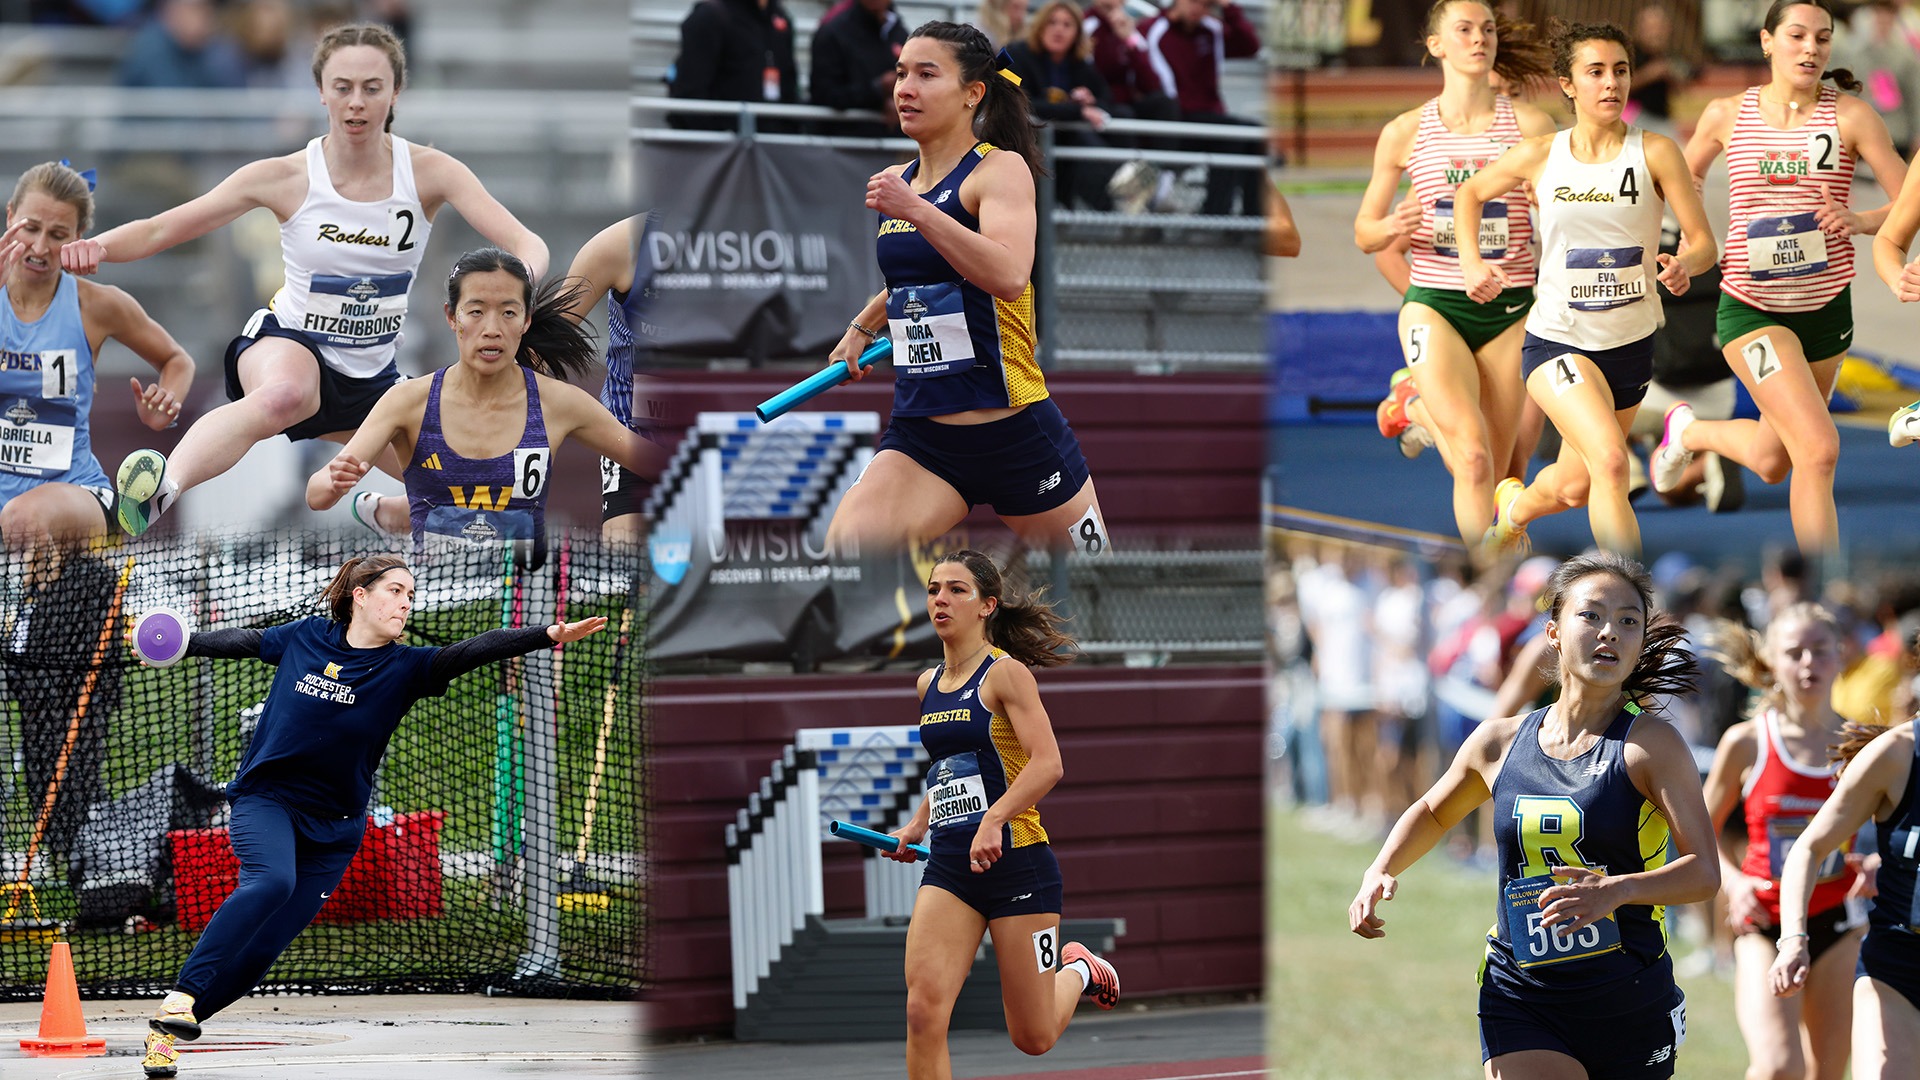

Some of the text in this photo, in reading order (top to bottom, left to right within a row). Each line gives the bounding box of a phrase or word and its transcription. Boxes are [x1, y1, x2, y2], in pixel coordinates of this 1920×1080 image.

[1815, 133, 1834, 170] 2
[1445, 169, 1480, 184] WA
[1759, 160, 1808, 175] WASH
[1619, 167, 1639, 205] 4
[396, 209, 414, 252] 2
[1776, 238, 1800, 251] KATE
[1772, 250, 1806, 267] DELIA
[1598, 272, 1616, 283] EVA
[1571, 281, 1642, 299] CIUFFETELLI
[340, 302, 379, 317] MOLLY
[304, 313, 402, 336] FITZGIBBONS
[905, 323, 935, 341] NORA
[908, 341, 943, 364] CHEN
[1410, 327, 1424, 363] 5
[1, 351, 43, 371] DEN
[1556, 357, 1577, 386] 4
[1748, 341, 1775, 379] 2
[51, 355, 66, 396] 1
[1, 444, 34, 465] NYE
[522, 452, 541, 498] 6
[447, 485, 514, 512] W
[1080, 517, 1103, 558] 8
[294, 680, 356, 705] TRACK & FIELD
[302, 673, 352, 694] ROCHESTER
[1512, 794, 1596, 881] R
[1039, 932, 1054, 969] 8
[153, 1043, 174, 1058] NIKE
